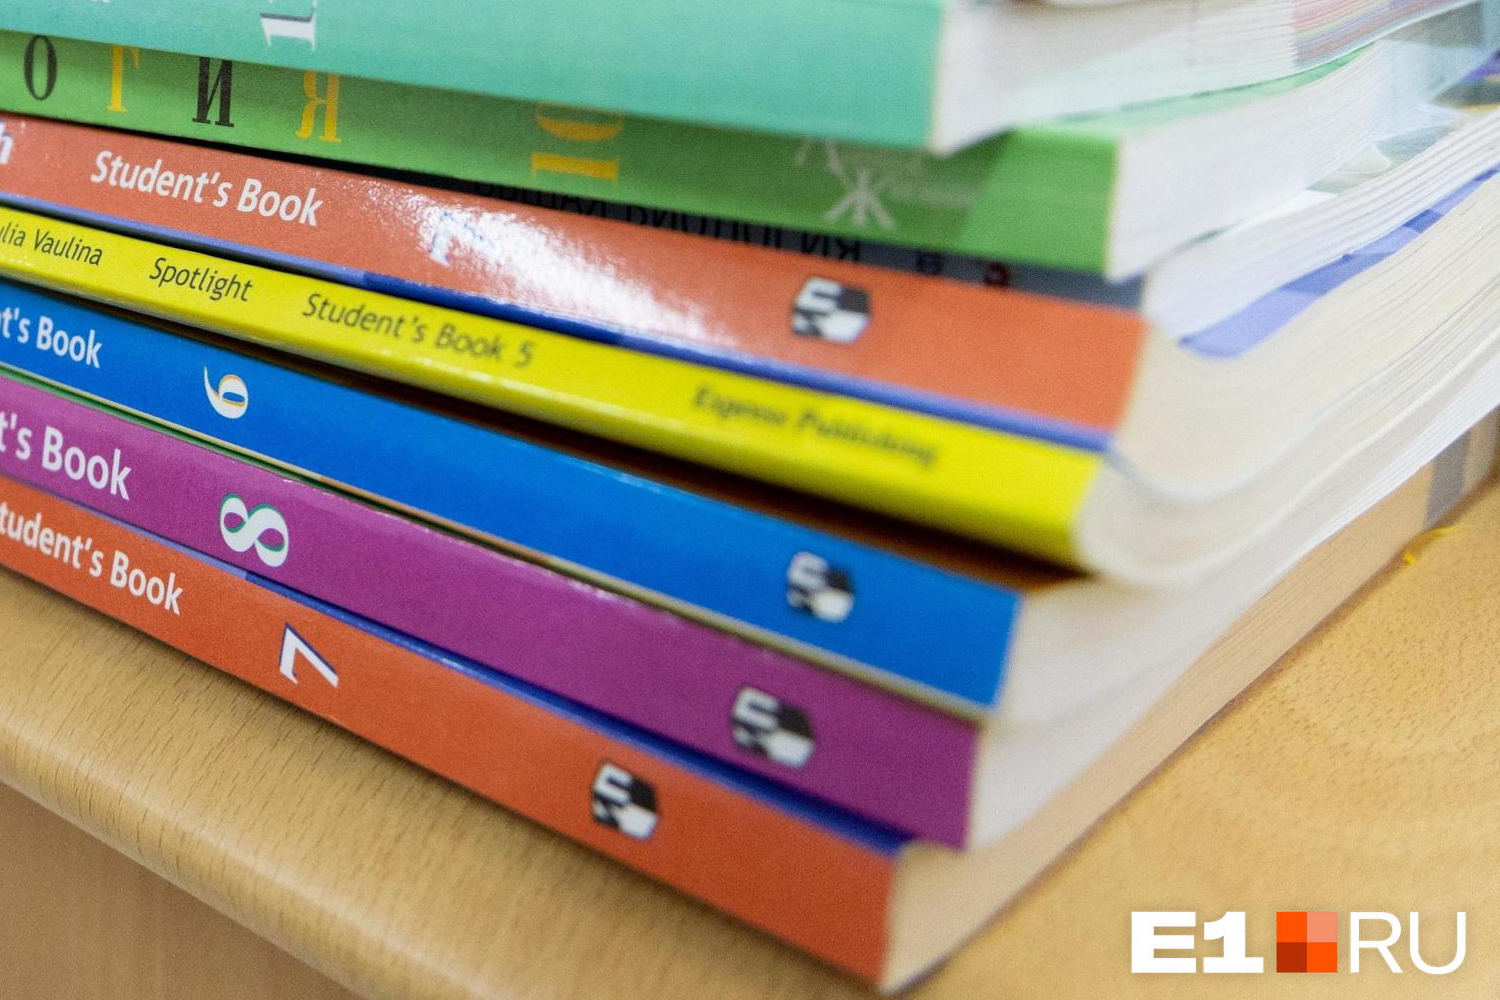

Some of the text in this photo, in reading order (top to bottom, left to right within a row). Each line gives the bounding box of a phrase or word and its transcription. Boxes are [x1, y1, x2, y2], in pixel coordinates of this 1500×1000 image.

[90, 149, 232, 209] Student's
[237, 178, 324, 227] Book
[33, 228, 104, 266] Vaulina
[148, 256, 254, 302] Spotlight
[302, 292, 427, 343] Student's
[435, 322, 505, 360] Book
[514, 339, 537, 370] 5
[36, 316, 103, 369] Book
[204, 364, 249, 420] 6
[41, 424, 132, 501] Book
[219, 492, 290, 569] 8
[109, 549, 185, 617] Book
[279, 621, 339, 687] 7
